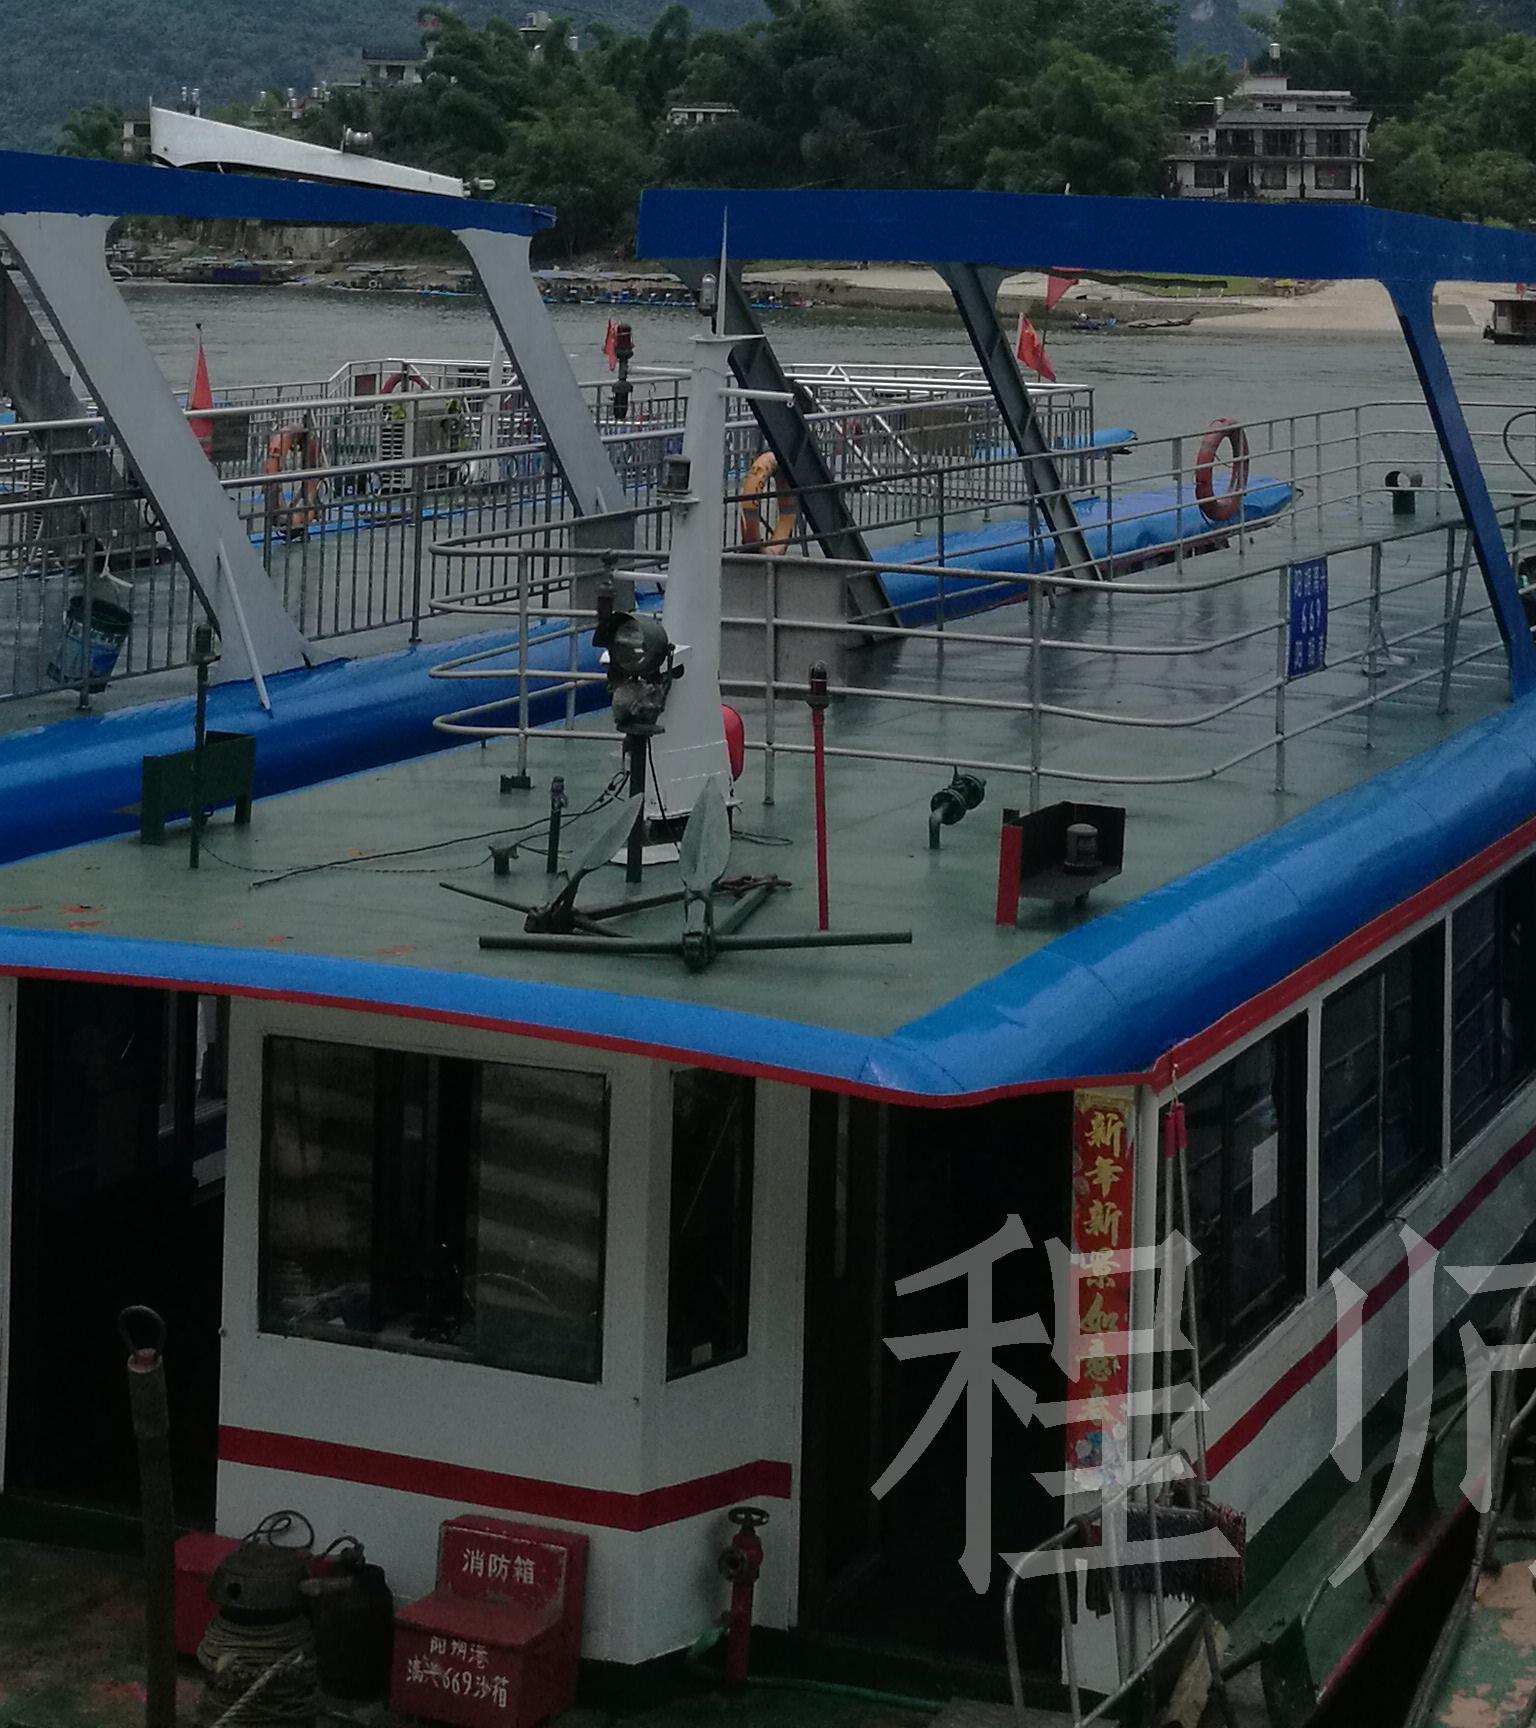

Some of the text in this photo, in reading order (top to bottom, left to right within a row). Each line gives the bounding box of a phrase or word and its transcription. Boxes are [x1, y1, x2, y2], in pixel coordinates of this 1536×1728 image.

[1301, 598, 1321, 634] 669
[462, 1547, 536, 1585] 消防箱
[429, 1635, 490, 1669] 阳朔港
